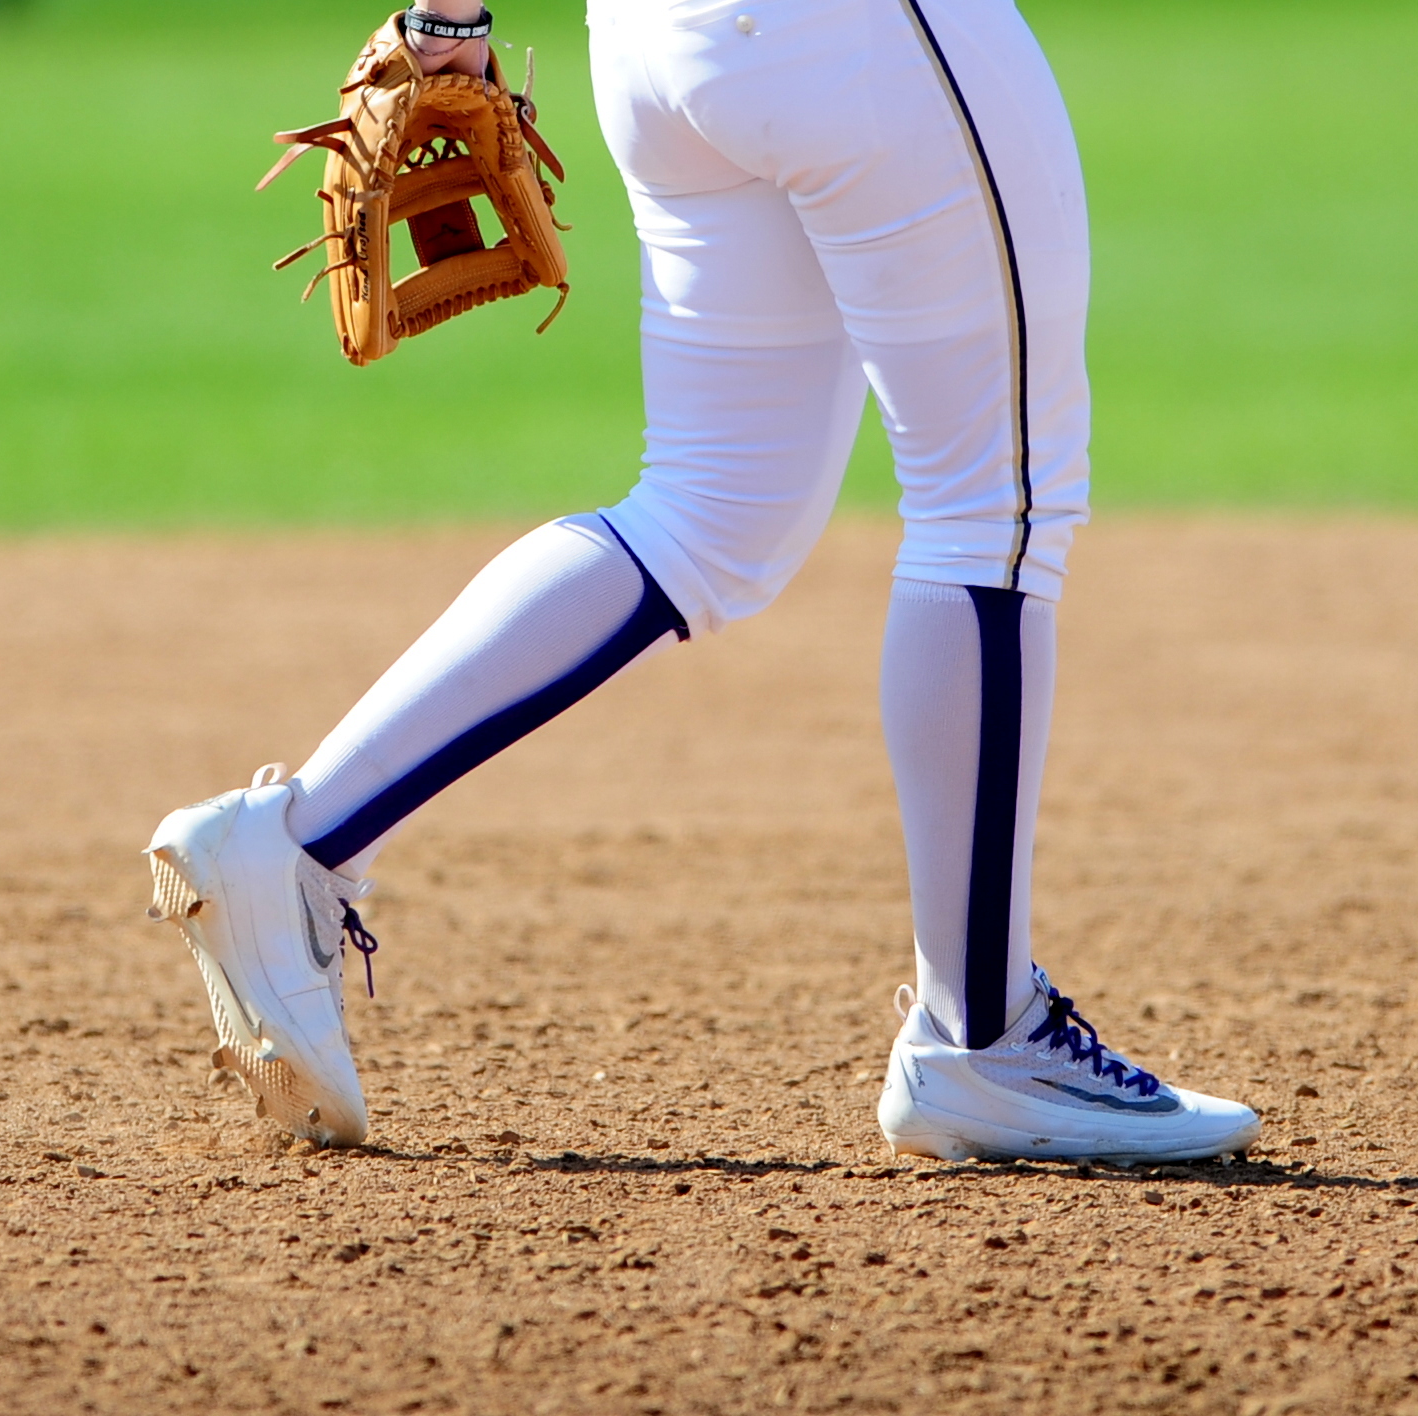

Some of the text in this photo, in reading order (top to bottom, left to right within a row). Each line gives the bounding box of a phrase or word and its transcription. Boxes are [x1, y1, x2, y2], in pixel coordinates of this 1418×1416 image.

[425, 23, 432, 32] IT
[434, 25, 455, 37] CALM
[456, 27, 471, 37] AND
[357, 210, 370, 303] Hand Crafted
